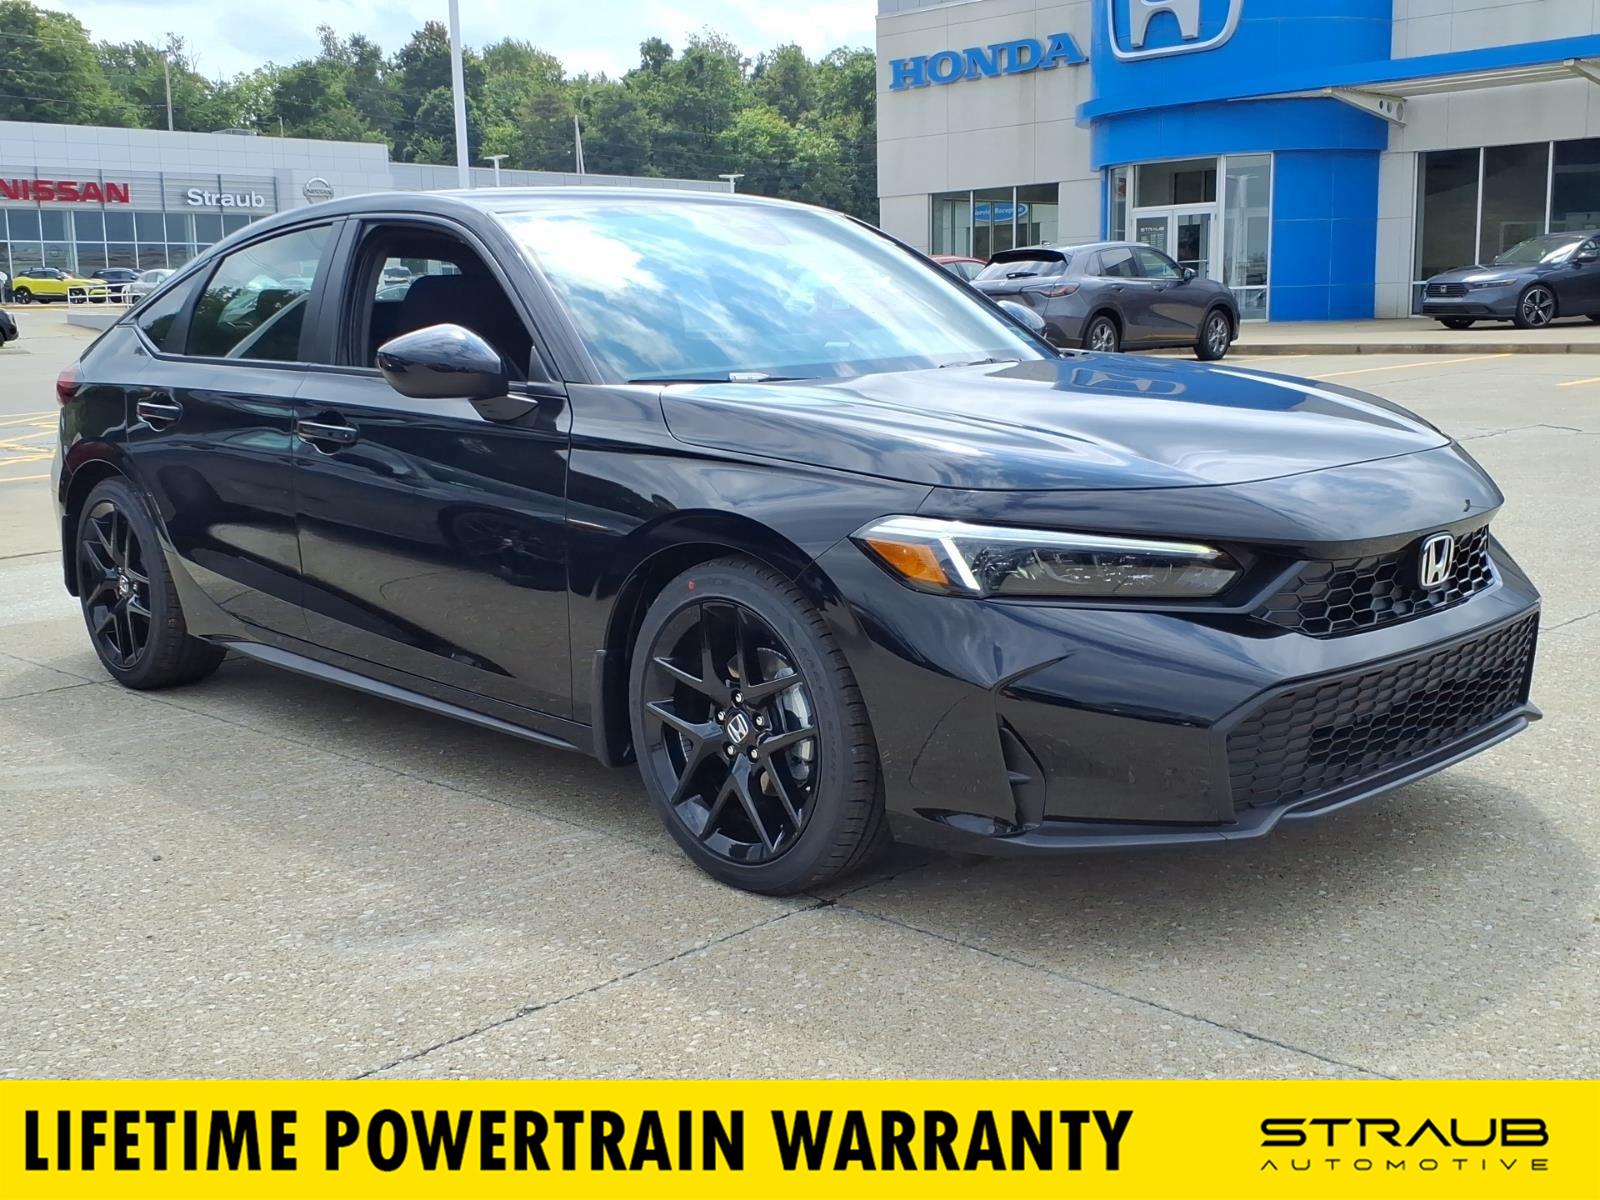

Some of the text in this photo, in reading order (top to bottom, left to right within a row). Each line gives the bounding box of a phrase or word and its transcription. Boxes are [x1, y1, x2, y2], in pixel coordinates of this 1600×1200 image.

[889, 32, 1088, 91] HONDA
[0, 178, 130, 203] NISSAN
[187, 188, 265, 208] Straub
